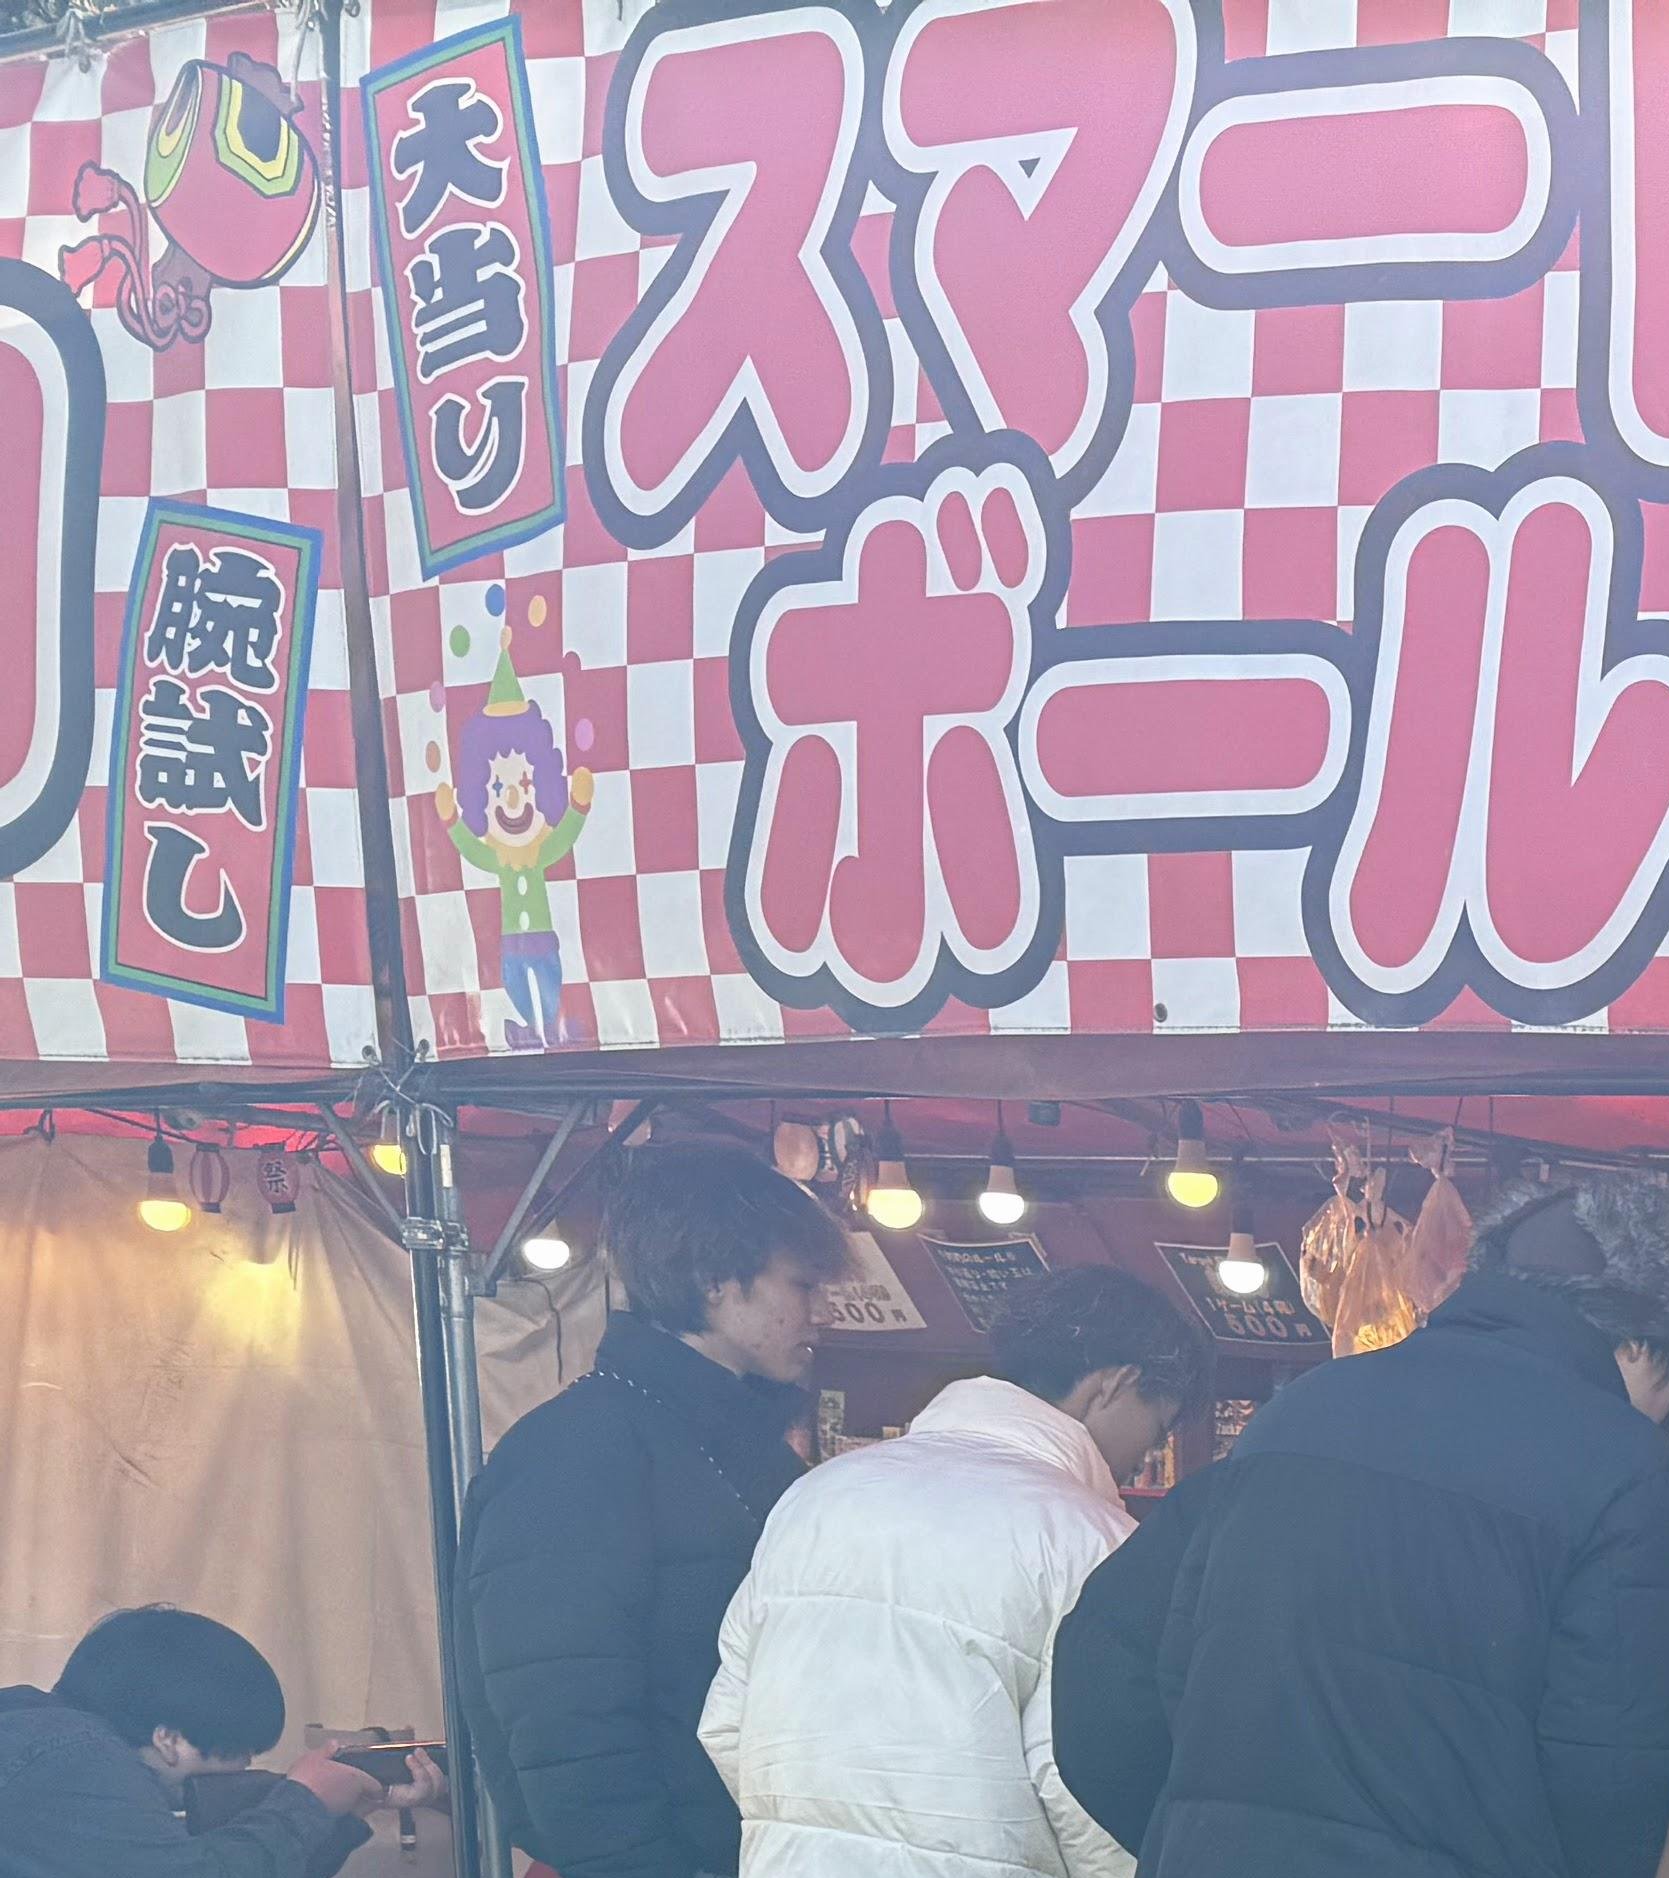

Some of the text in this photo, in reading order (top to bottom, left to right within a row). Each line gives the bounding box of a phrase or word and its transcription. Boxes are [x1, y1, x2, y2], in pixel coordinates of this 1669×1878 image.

[393, 76, 532, 517] 大当り
[135, 542, 284, 954] 腕試し
